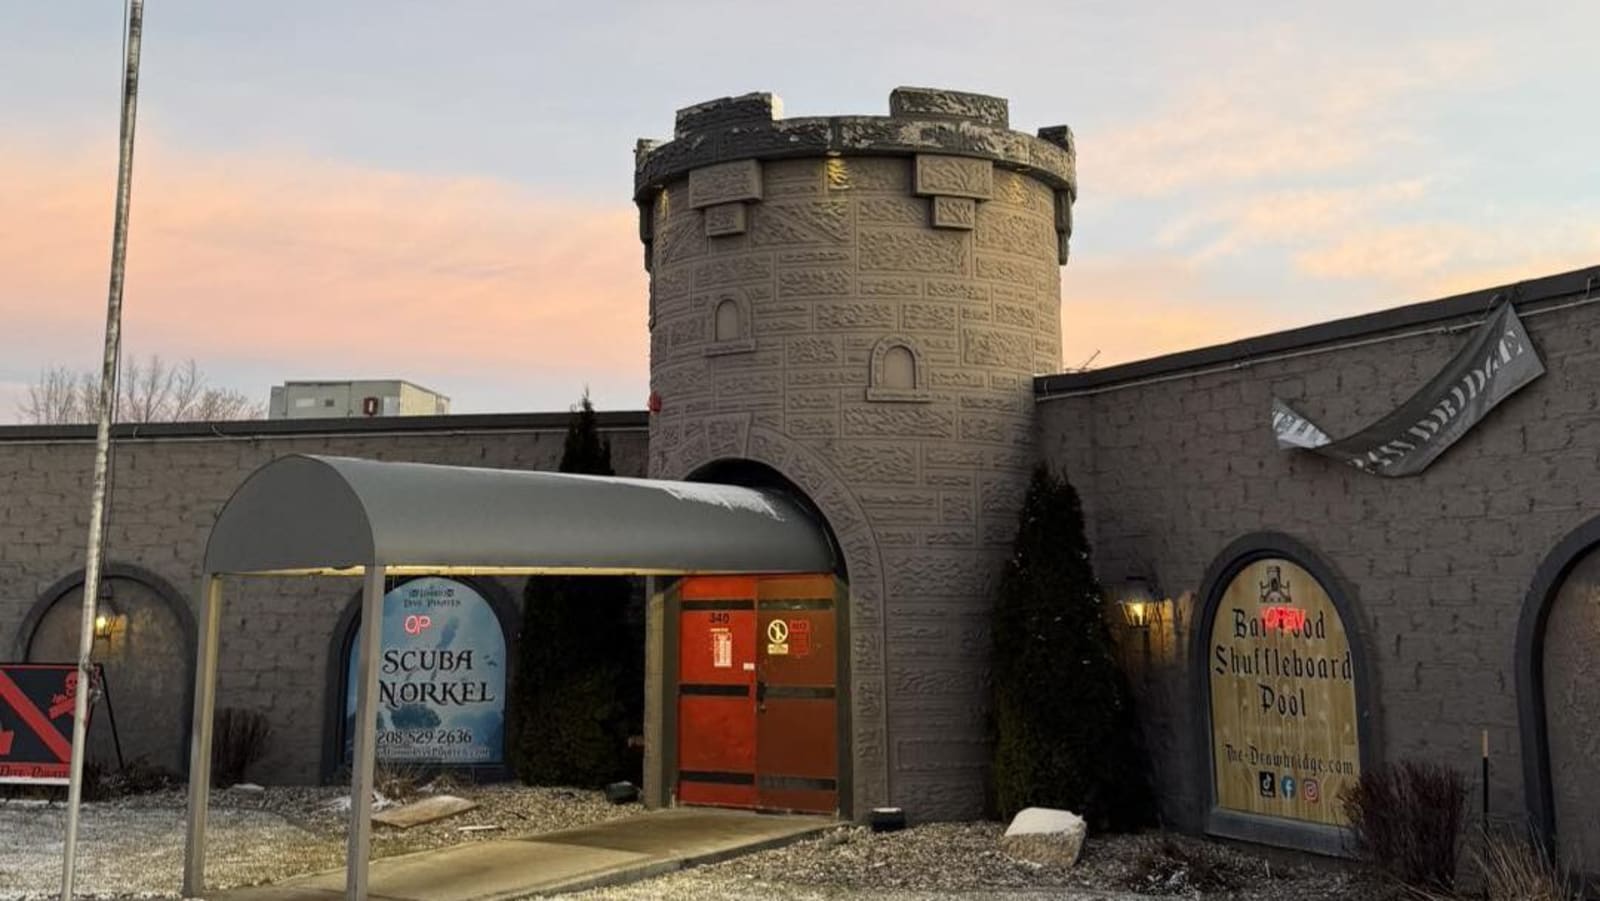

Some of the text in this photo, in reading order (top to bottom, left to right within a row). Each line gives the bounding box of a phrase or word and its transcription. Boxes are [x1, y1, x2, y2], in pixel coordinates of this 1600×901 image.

[382, 650, 473, 674] SCUBA
[1215, 644, 1353, 680] Shuffleboard
[1258, 683, 1307, 717] Pool
